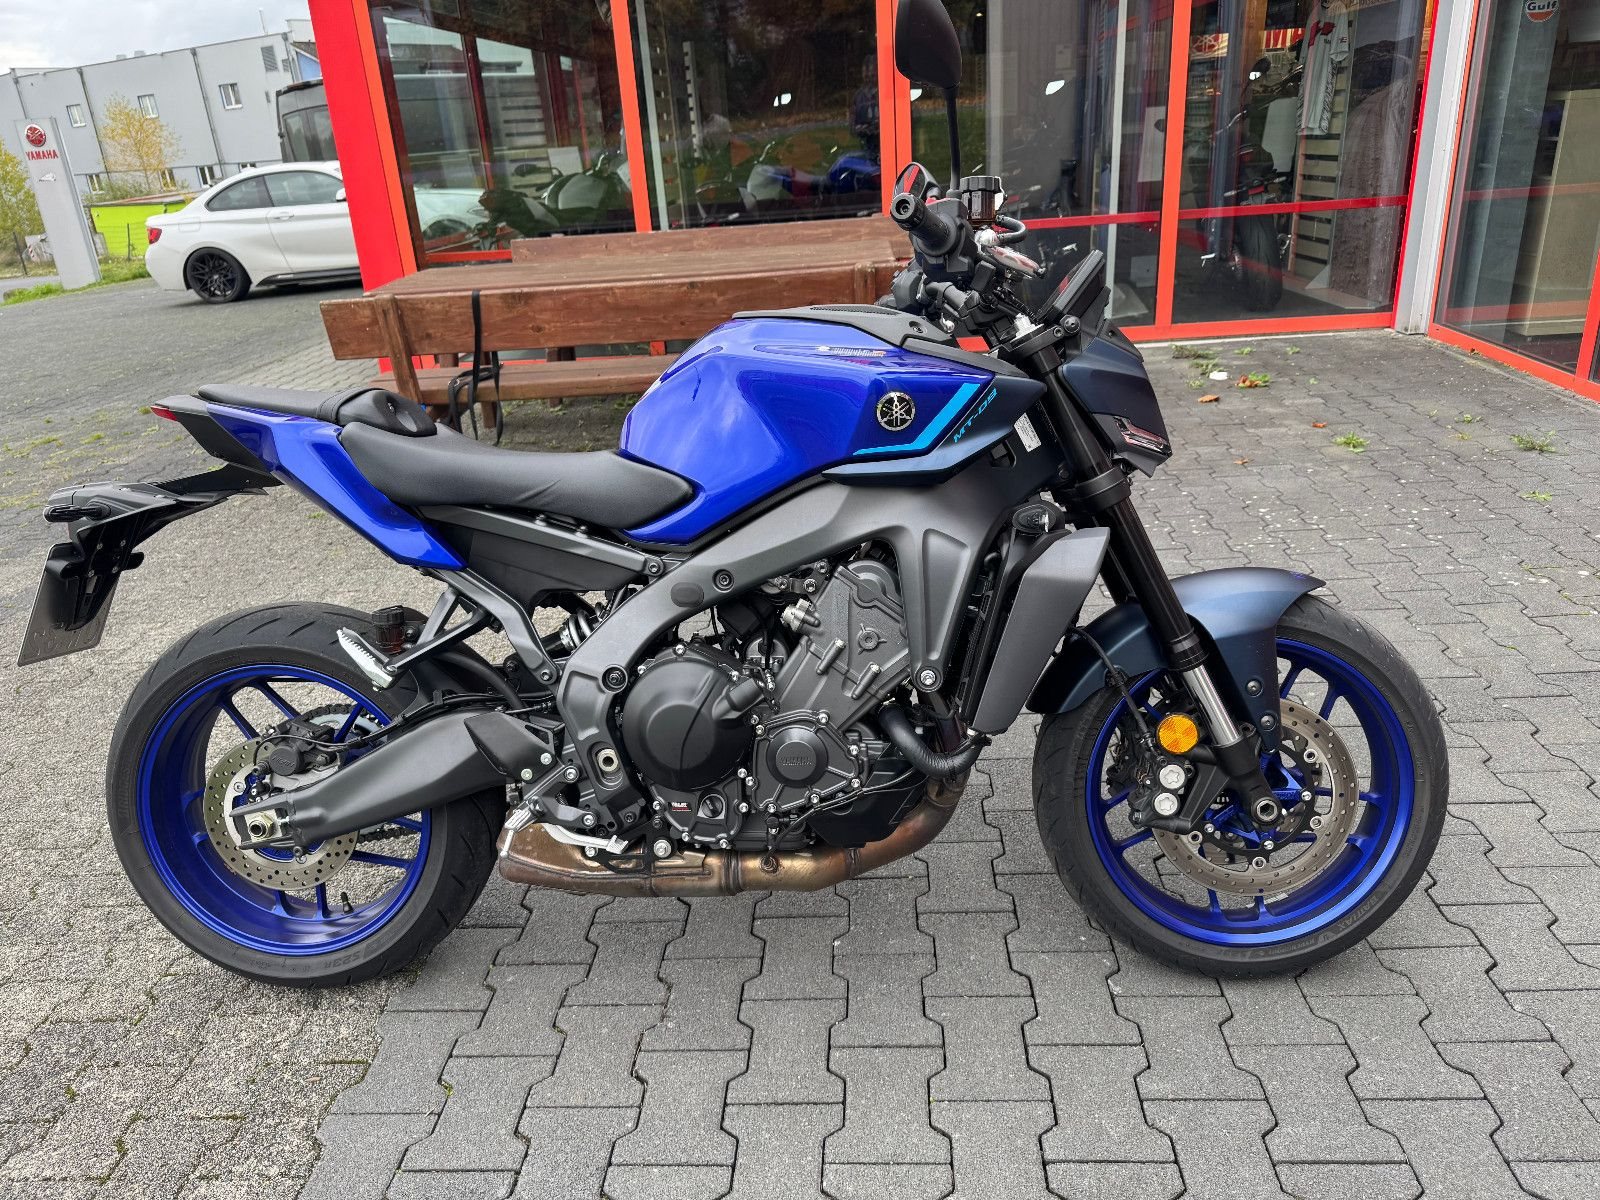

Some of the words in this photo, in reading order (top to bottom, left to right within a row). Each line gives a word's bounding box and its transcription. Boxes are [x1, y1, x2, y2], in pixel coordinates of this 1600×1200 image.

[1527, 0, 1557, 11] Gulf
[25, 149, 59, 161] YAMAHA
[953, 388, 998, 443] MT-09
